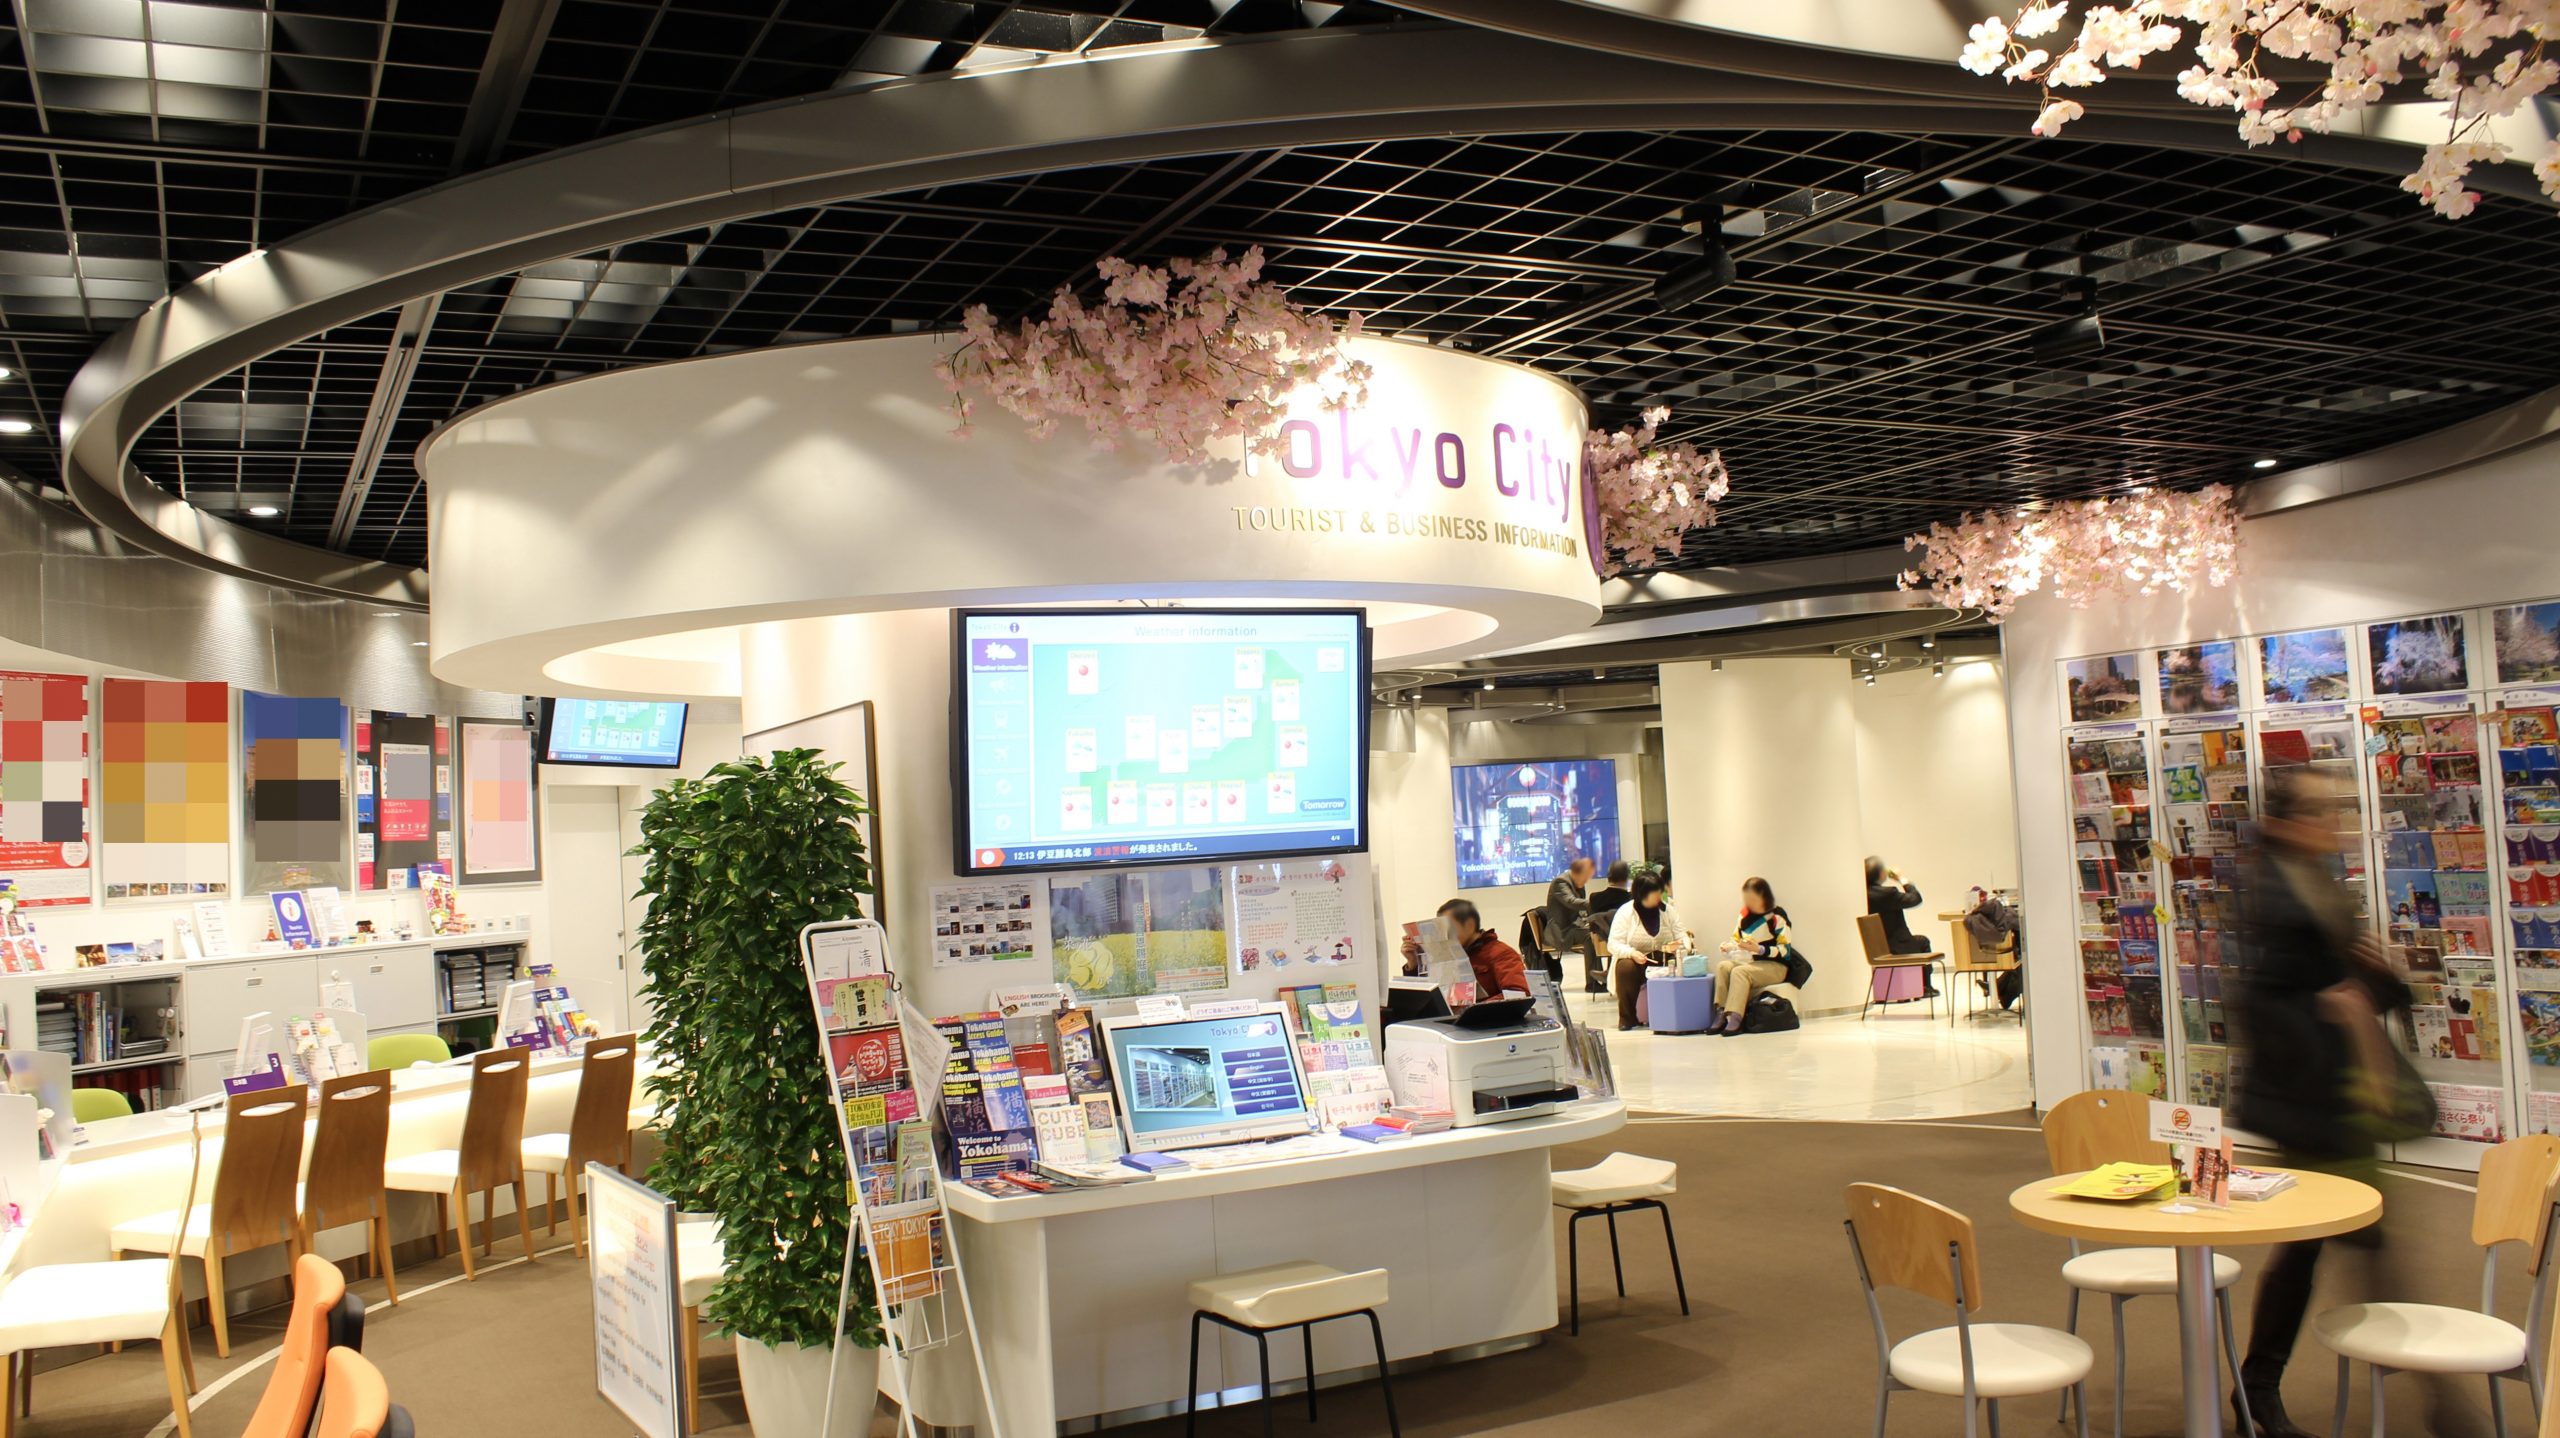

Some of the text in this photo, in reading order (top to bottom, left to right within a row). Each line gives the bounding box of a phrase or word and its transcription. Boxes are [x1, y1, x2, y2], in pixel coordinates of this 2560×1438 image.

[1493, 423, 1571, 524] City
[1231, 506, 1577, 558] TOURIST & BUSINESS INFORMATION
[1134, 626, 1257, 637] Weather information
[1302, 800, 1345, 811] Tomorrow
[1013, 851, 1035, 861] 12:13
[1505, 860, 1526, 870] Down
[1527, 859, 1546, 868] Town
[1004, 994, 1029, 1002] ENGLISH
[538, 1019, 544, 1028] 4
[966, 1021, 1003, 1032] Yokohama
[967, 1029, 1004, 1040] Access Guide
[1211, 1026, 1238, 1037] Tokyo
[973, 1047, 1009, 1059] Yokohama
[271, 1057, 279, 1068] 3
[993, 1055, 1010, 1063] Guide
[981, 1071, 1018, 1082] Yokohama
[982, 1079, 1019, 1090] Access Guide
[1004, 1090, 1028, 1129] 横浜
[1038, 1109, 1083, 1125] CUTE
[957, 1136, 993, 1146] Welcome
[958, 1138, 1033, 1159] Yokohama!
[901, 1216, 927, 1233] TOKYO
[880, 1222, 900, 1239] TOKY
